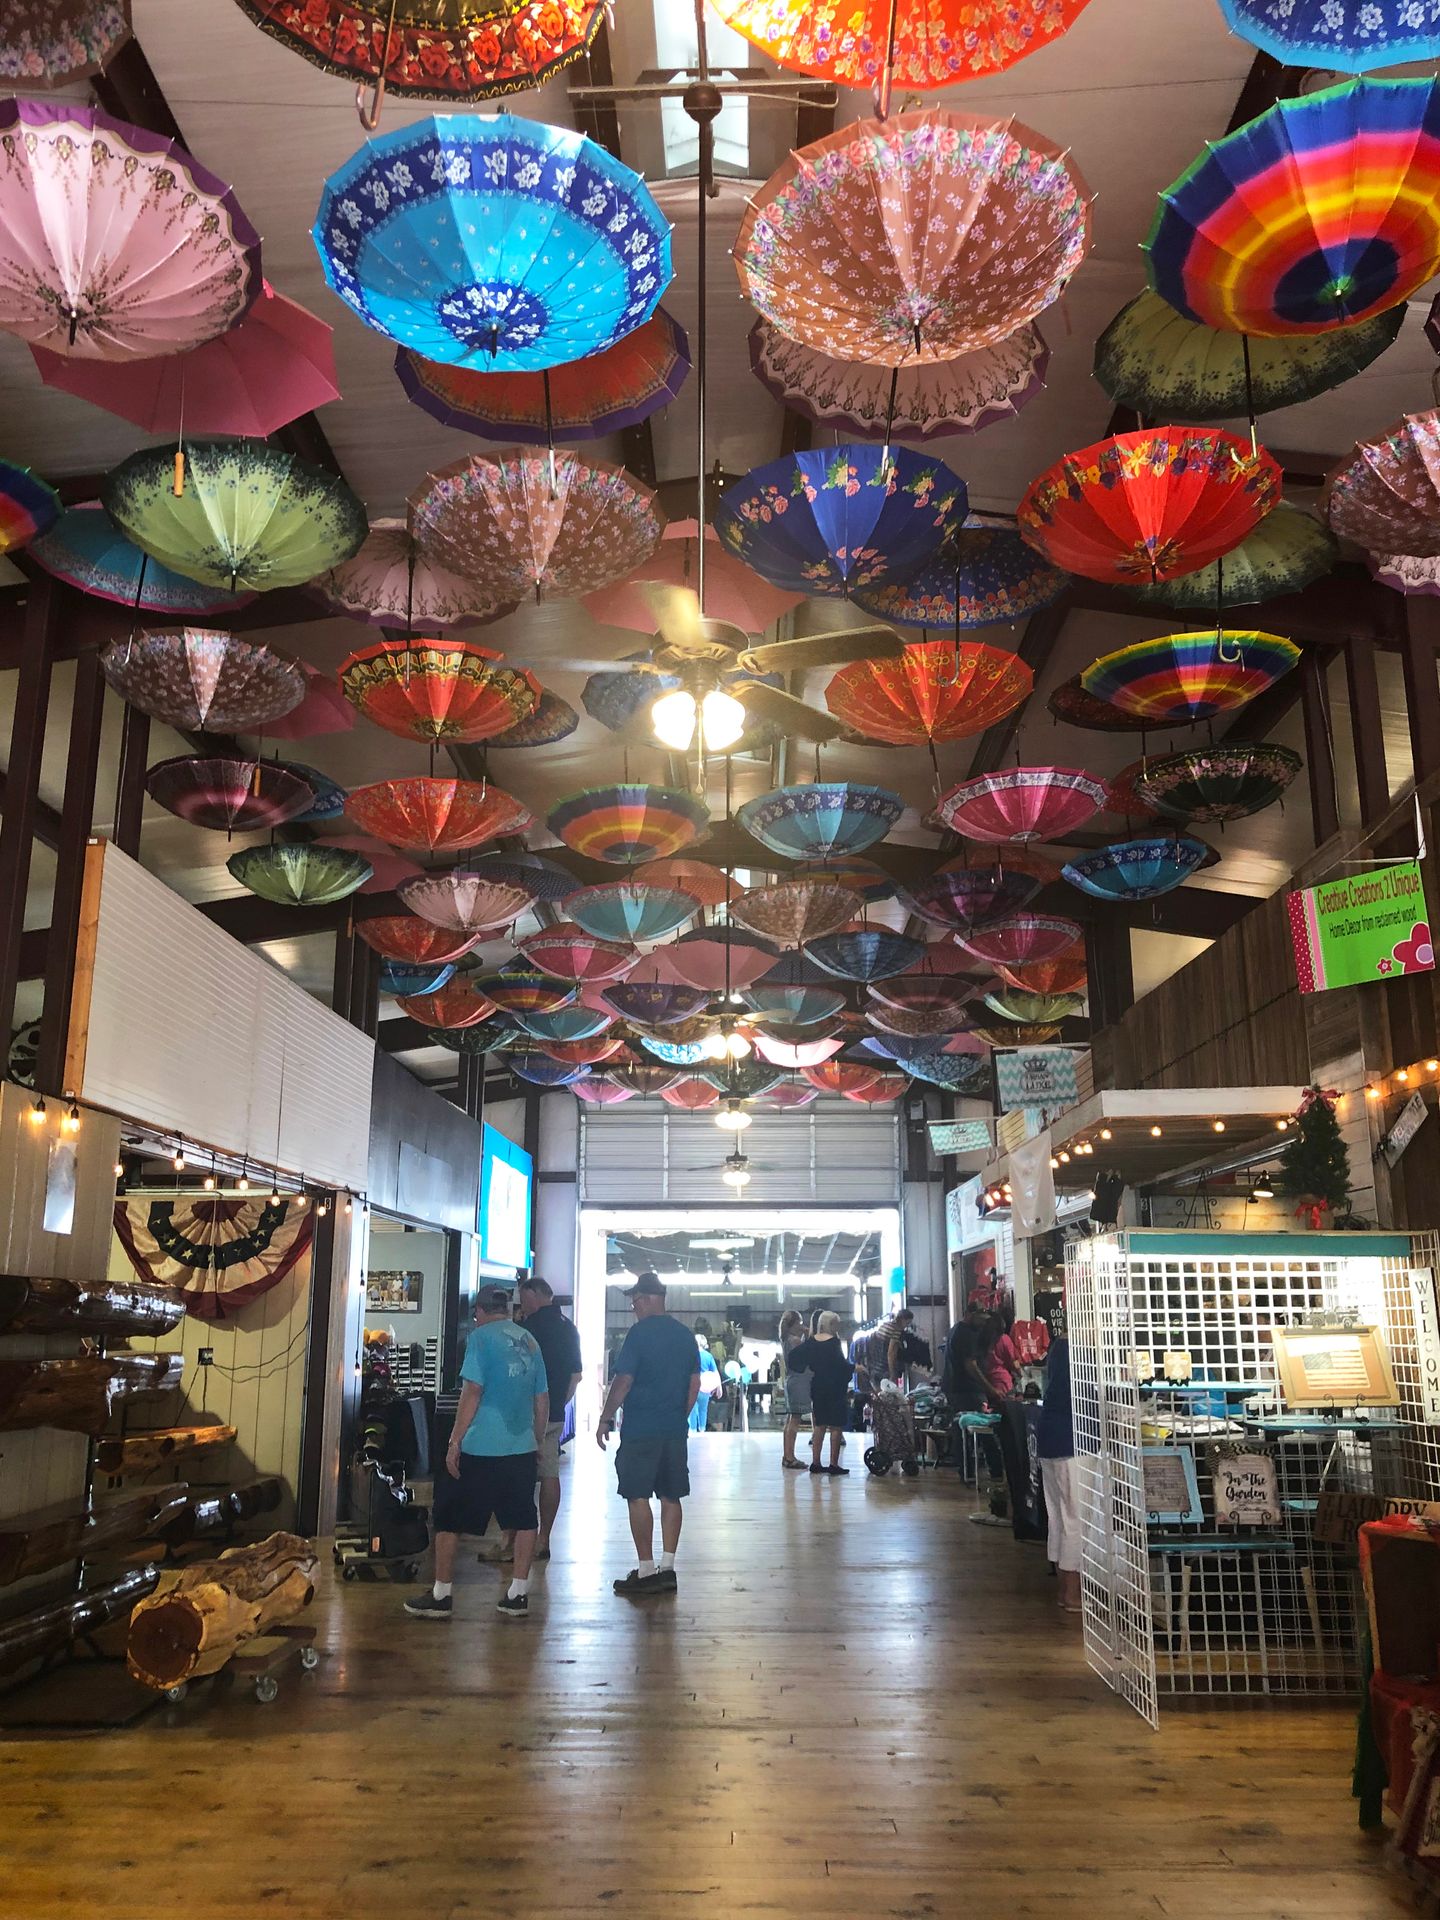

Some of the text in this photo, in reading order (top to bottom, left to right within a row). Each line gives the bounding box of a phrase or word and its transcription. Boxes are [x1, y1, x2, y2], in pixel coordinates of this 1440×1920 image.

[1318, 886, 1349, 915] Creative
[1349, 879, 1384, 907] Creations
[1390, 869, 1420, 899] Unique
[1329, 904, 1417, 938] Home Decor from reclaimed wood
[1415, 1280, 1440, 1412] WELCOME
[1223, 1471, 1267, 1486] In The
[1226, 1486, 1267, 1501] Garden
